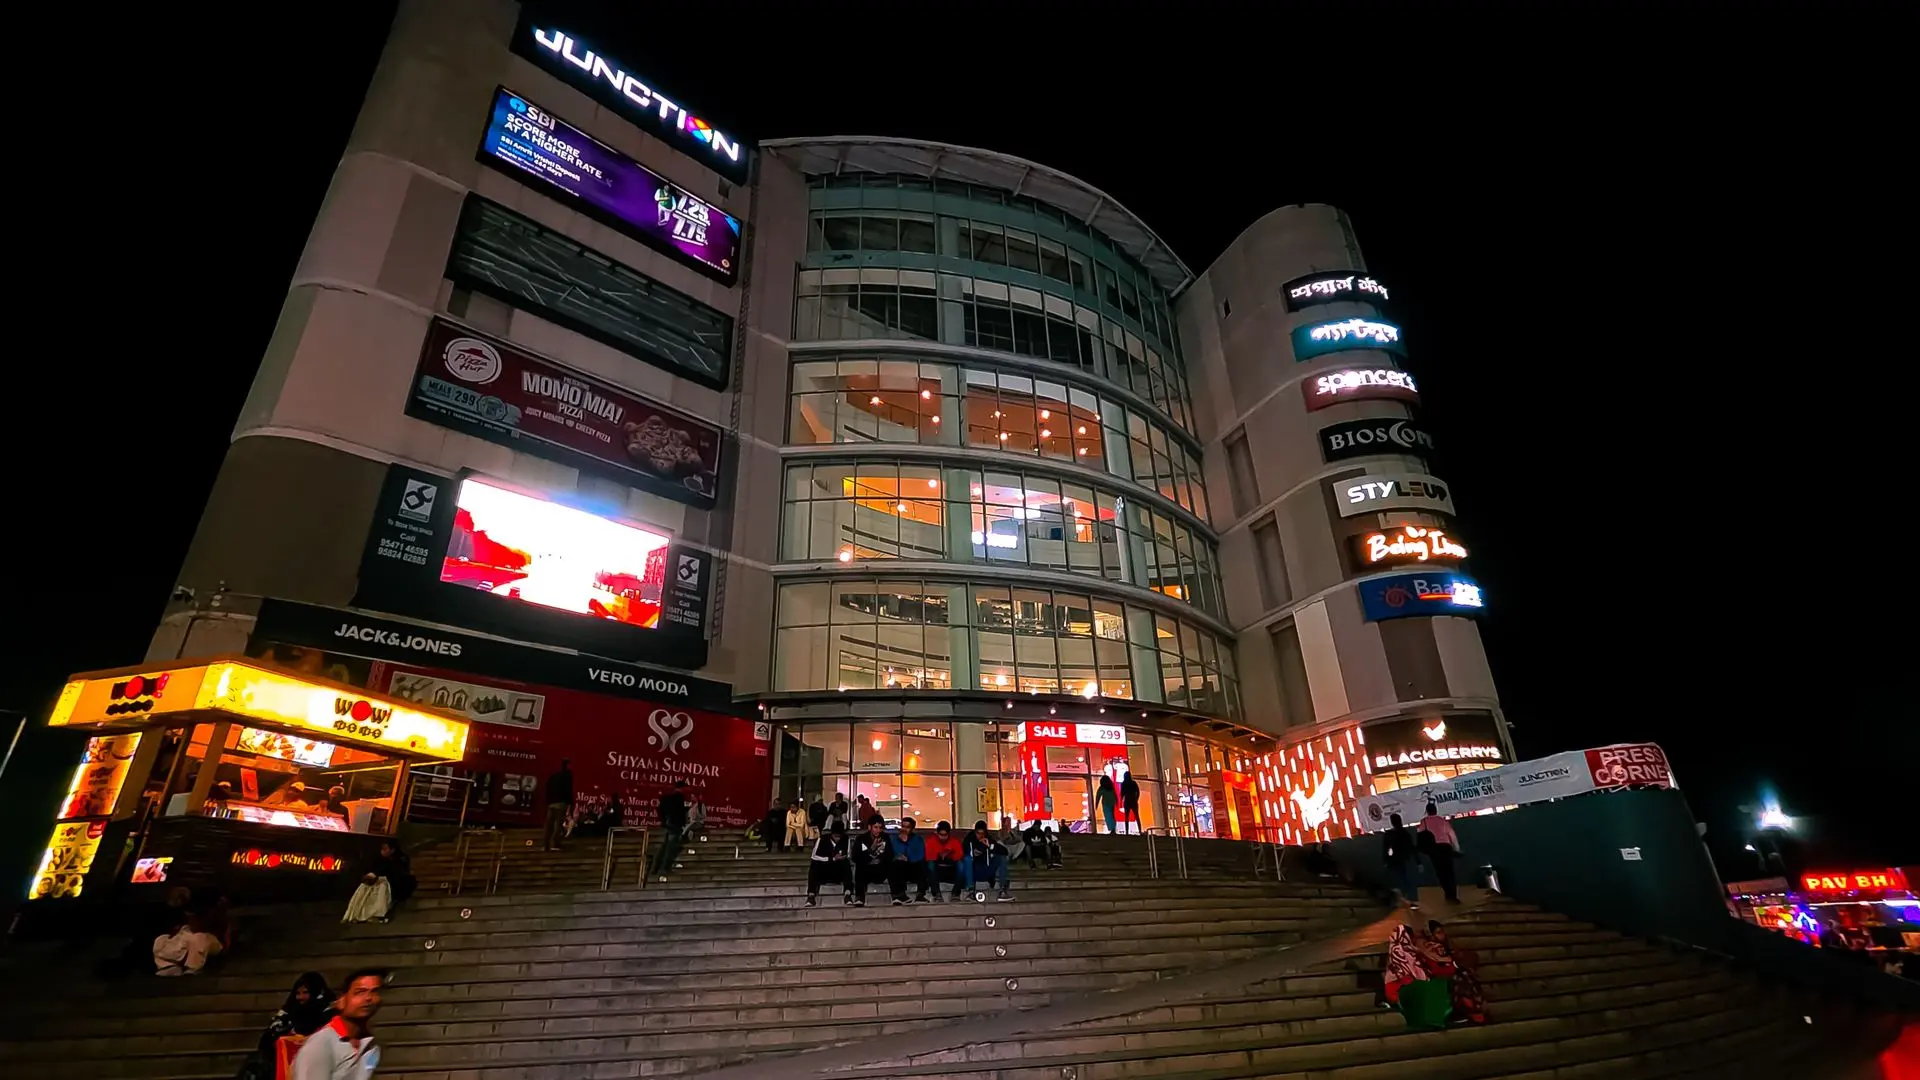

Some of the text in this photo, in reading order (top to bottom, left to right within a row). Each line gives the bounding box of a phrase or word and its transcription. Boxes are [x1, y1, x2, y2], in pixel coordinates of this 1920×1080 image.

[534, 28, 739, 161] JUNCTION
[527, 106, 556, 131] SBI
[500, 135, 514, 147] SBI
[506, 113, 546, 140] SCORE
[547, 134, 580, 158] MORE
[504, 121, 521, 136] AT
[521, 130, 530, 140] A
[532, 135, 575, 164] HIGHER
[575, 158, 603, 179] RATE
[454, 351, 489, 367] Pizza
[459, 361, 487, 373] Hut
[521, 371, 625, 425] MOMO MIA!
[558, 403, 585, 421] PIZZA
[596, 430, 612, 445] PIZZA
[400, 532, 416, 542] Call
[334, 623, 463, 657] JACK&JONES
[587, 667, 690, 697] VERO MODA
[1033, 725, 1067, 738] SALE
[1100, 729, 1121, 740] 299
[607, 751, 720, 777] SHYAM SUNDAR
[1375, 746, 1501, 768] BLACKBERRYS
[1599, 747, 1663, 768] PRESS
[1518, 766, 1570, 784] JUNCTION
[1595, 764, 1669, 784] CORNE
[1435, 784, 1495, 804] MARATHON 5K
[1806, 875, 1848, 889] PAV
